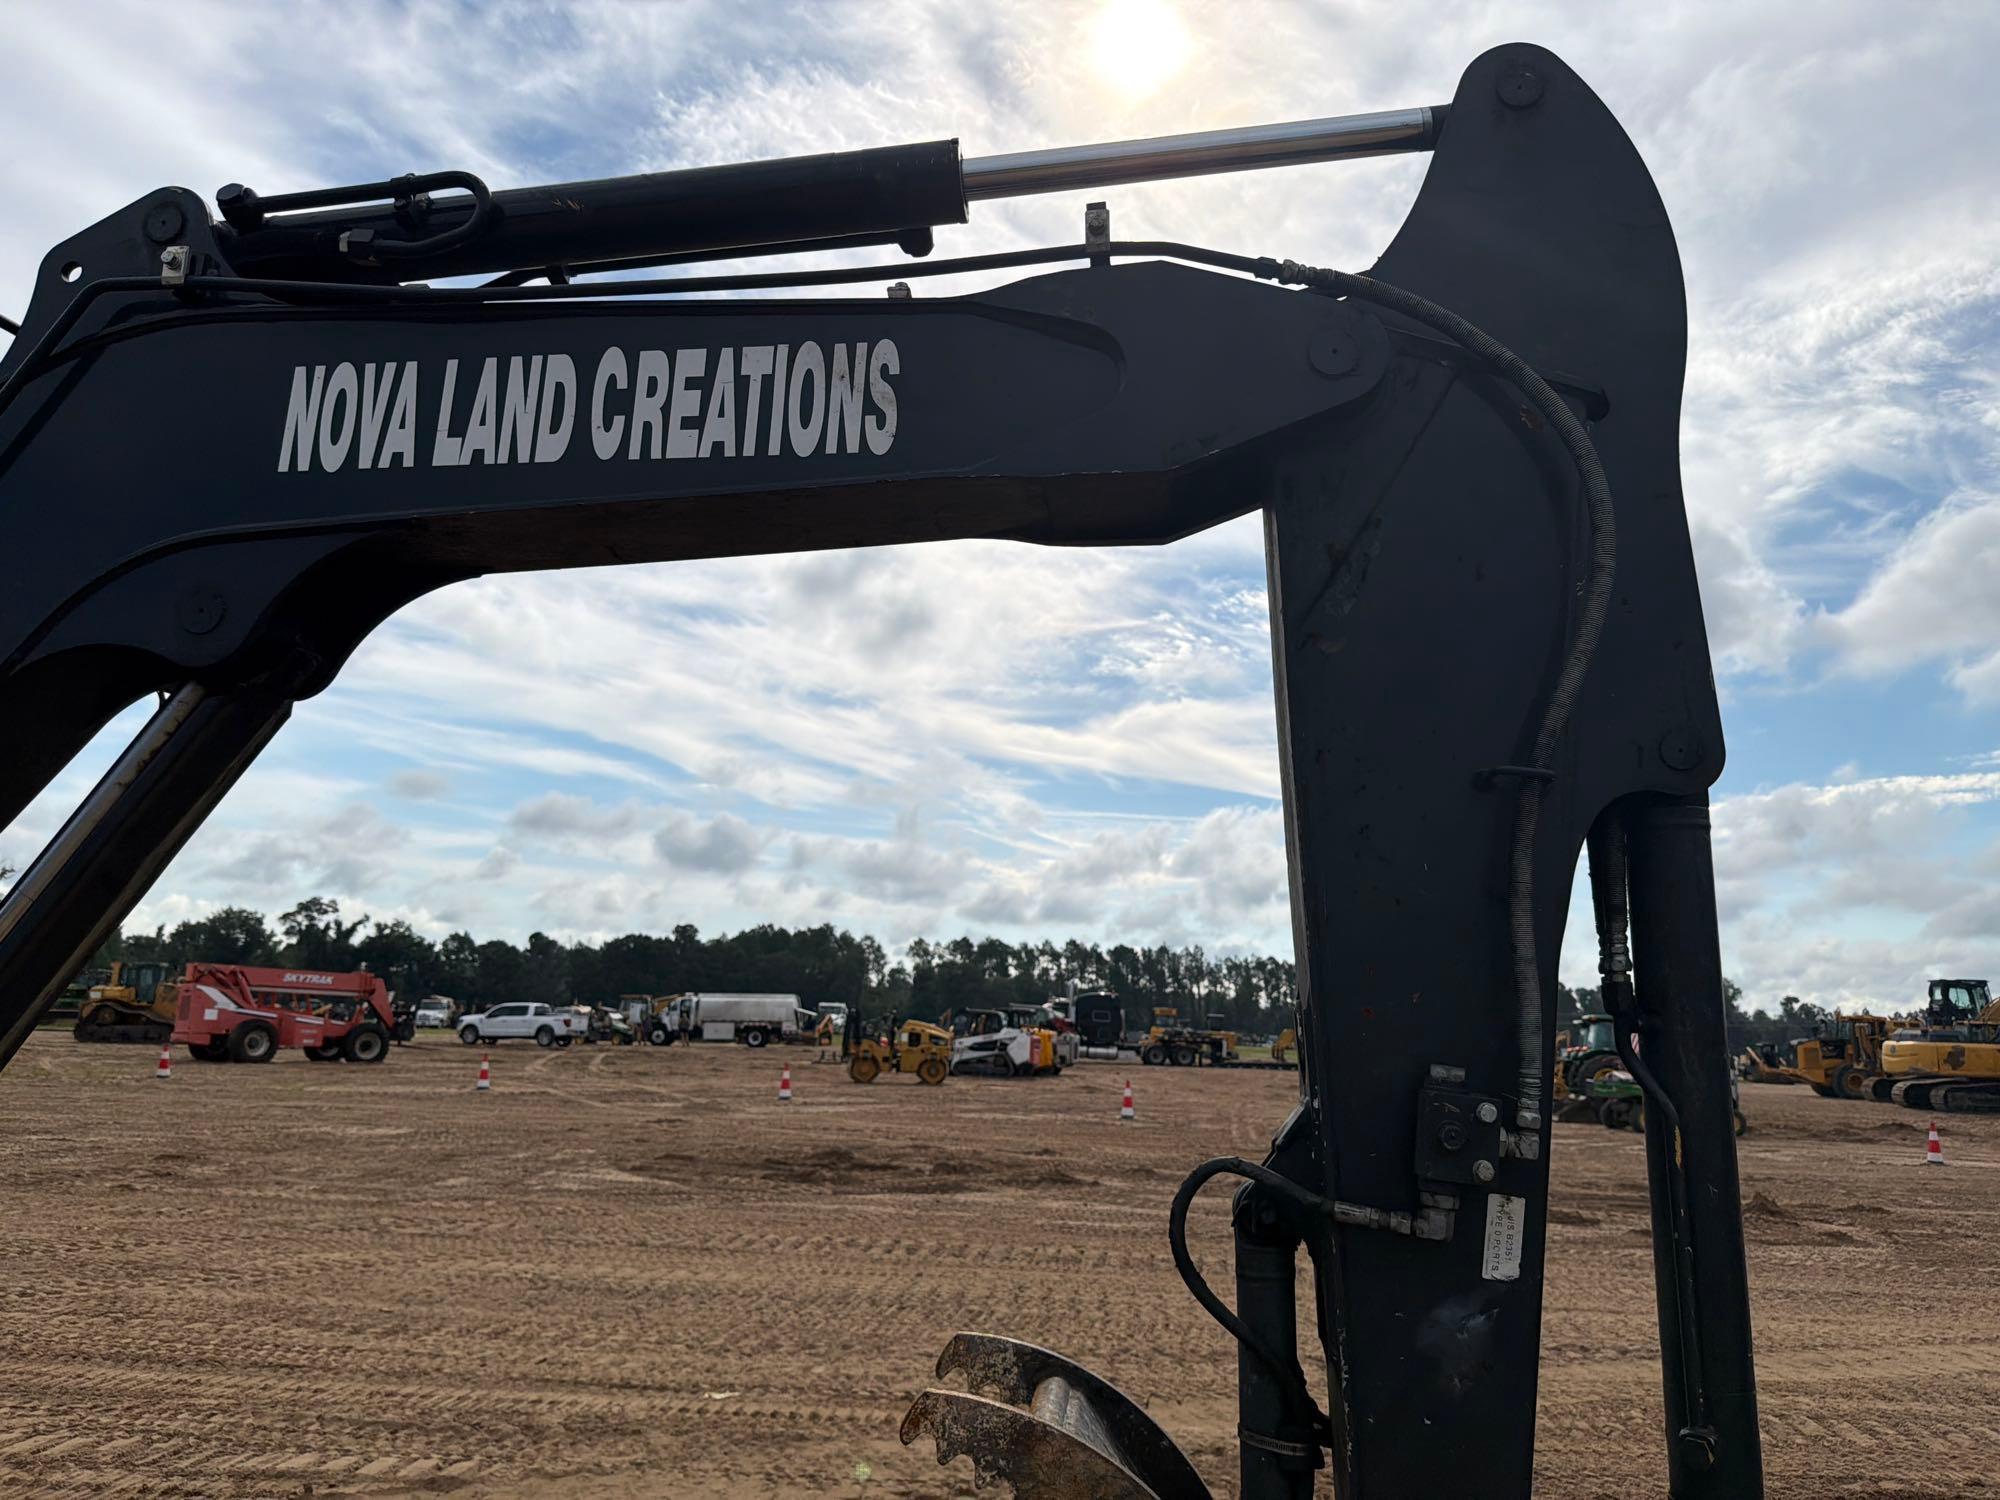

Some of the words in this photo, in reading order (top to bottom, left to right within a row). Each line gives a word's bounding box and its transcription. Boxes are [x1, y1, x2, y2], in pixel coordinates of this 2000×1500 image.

[277, 361, 418, 473] NOVA
[431, 353, 577, 467] LAND
[590, 338, 901, 461] CREATIONS
[284, 973, 334, 984] SKYTRAK
[1495, 1203, 1504, 1227] TYPE
